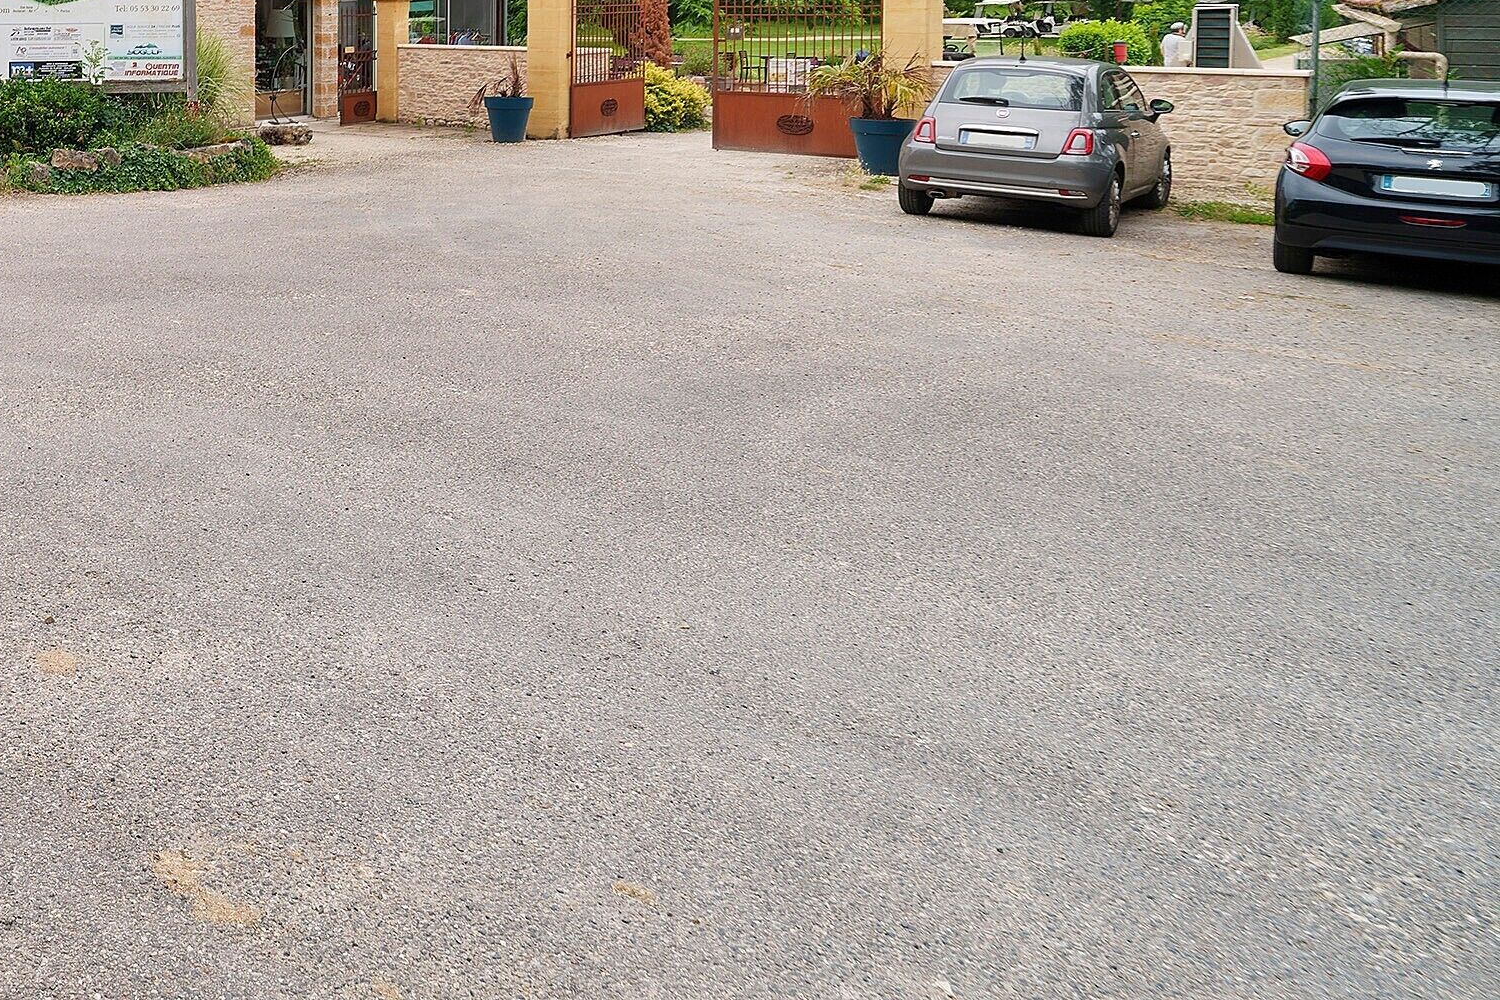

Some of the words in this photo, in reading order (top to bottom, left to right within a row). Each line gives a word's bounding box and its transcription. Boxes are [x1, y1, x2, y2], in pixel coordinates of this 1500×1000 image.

[115, 5, 128, 13] Tel:
[129, 4, 139, 13] 05
[140, 4, 150, 12] 53
[161, 4, 170, 12] 22
[145, 62, 180, 71] QUENTIN
